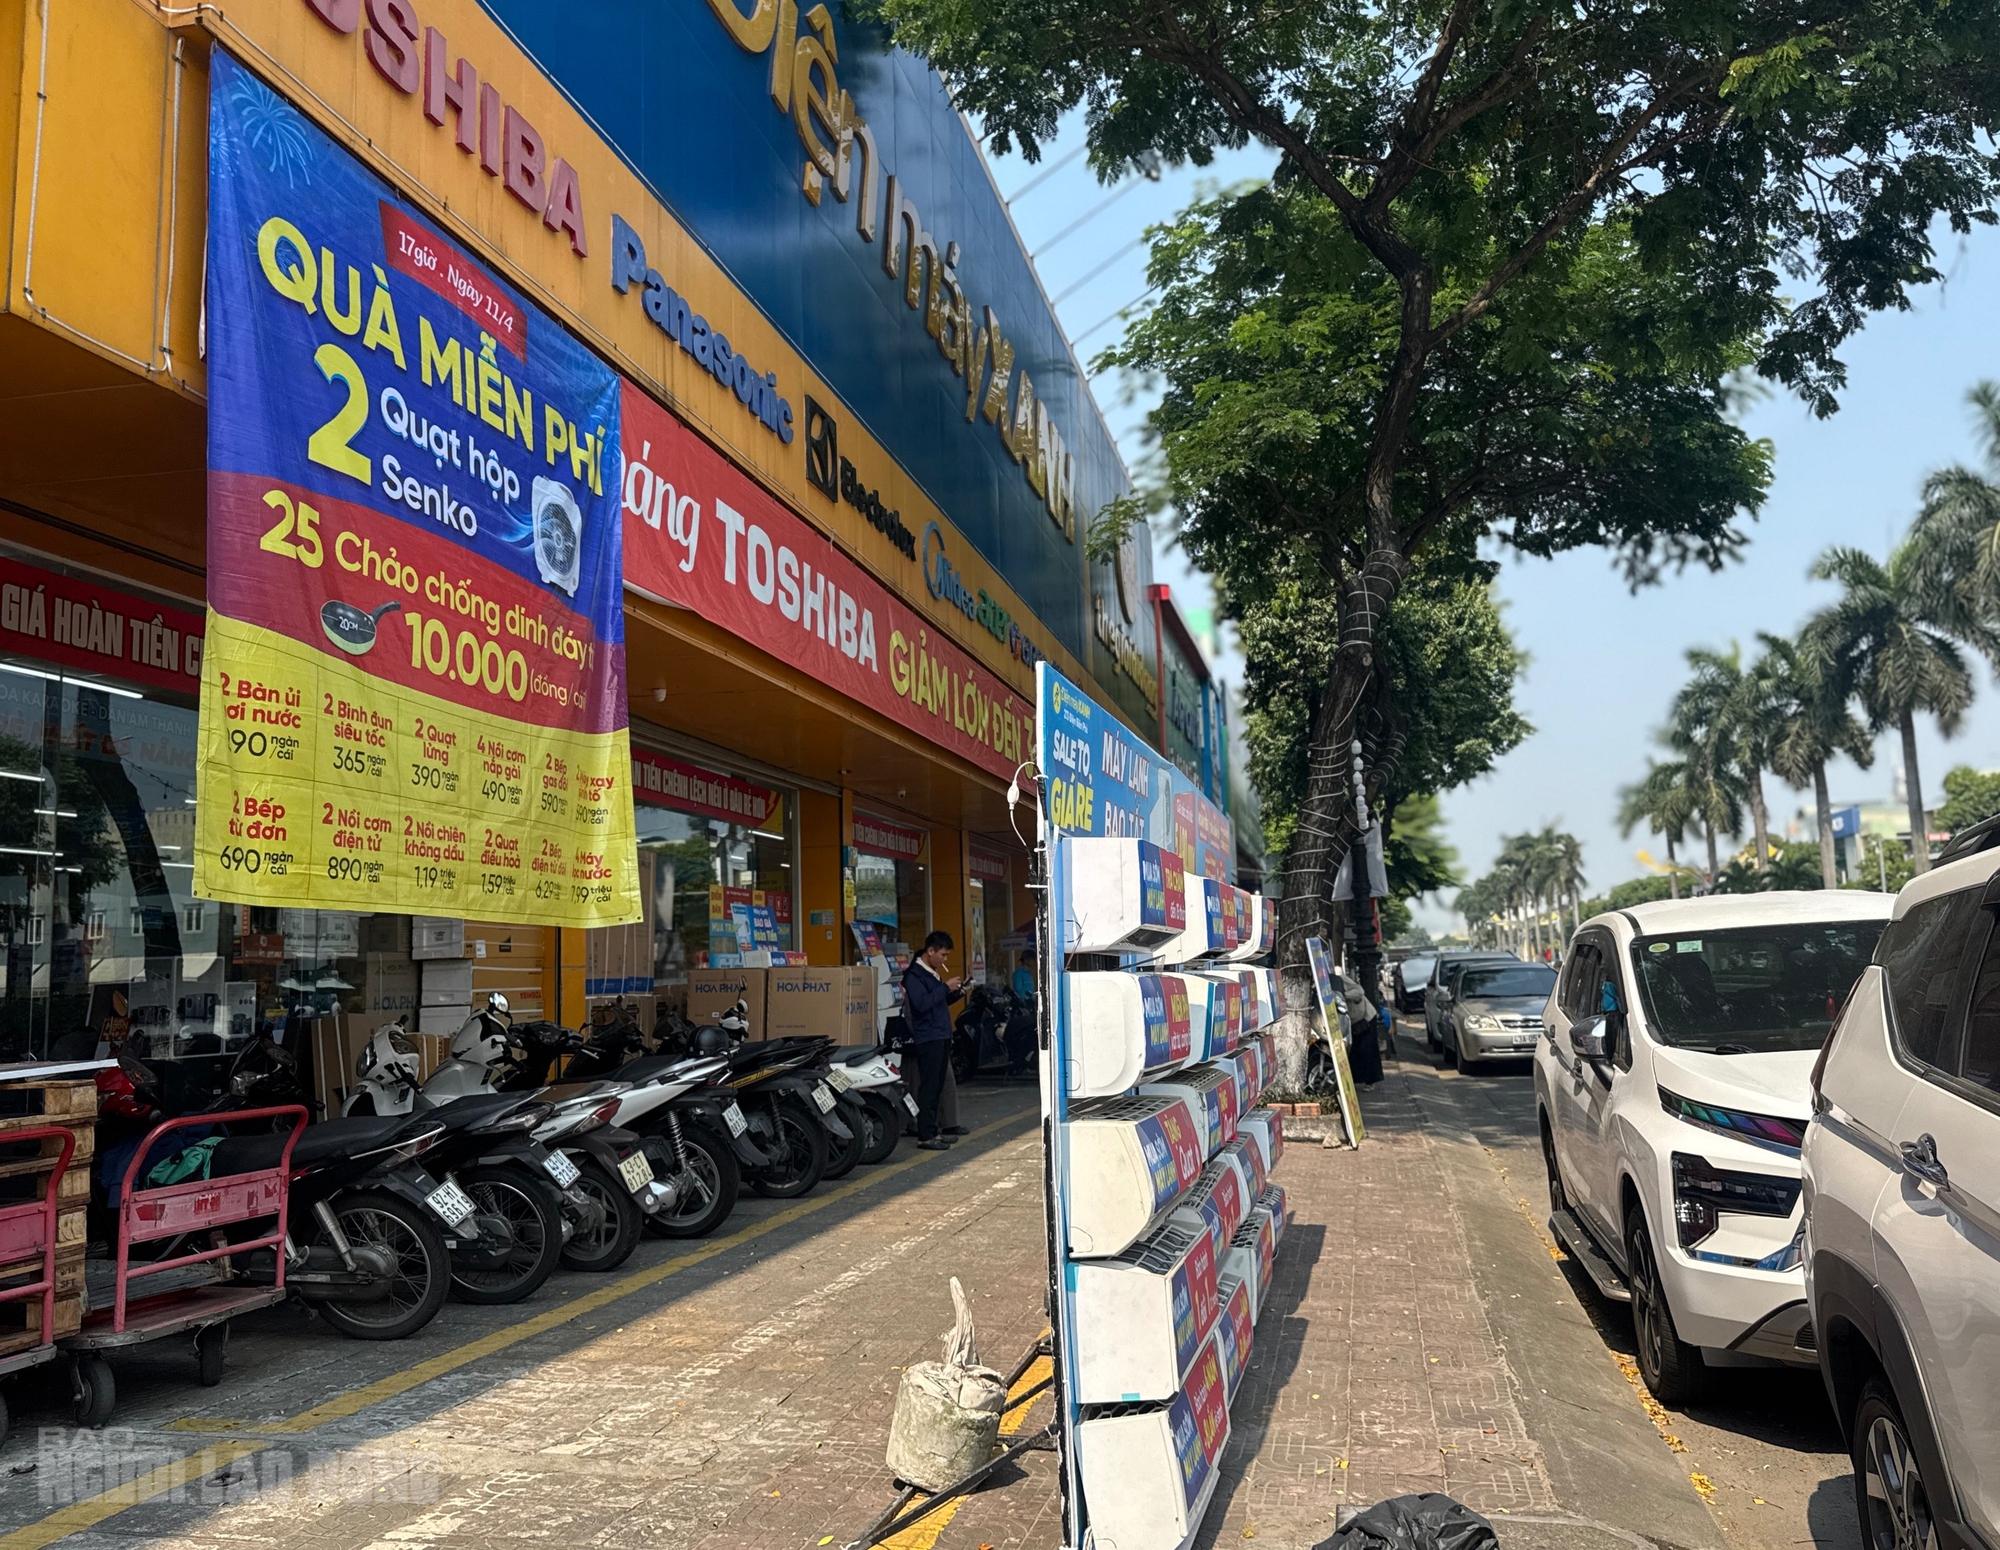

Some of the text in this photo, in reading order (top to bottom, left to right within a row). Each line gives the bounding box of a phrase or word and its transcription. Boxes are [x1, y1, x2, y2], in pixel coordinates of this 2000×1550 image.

[398, 230, 515, 333] 17giờ Ngày 11/4
[257, 216, 407, 372] QUÀ
[418, 315, 534, 453] MIỄN
[611, 213, 794, 444] Panasonic
[884, 174, 989, 424] máy
[982, 305, 1076, 545] XANH
[308, 343, 372, 486] 2
[380, 386, 520, 502] Quạt hộp
[381, 453, 478, 538] Senko
[259, 489, 587, 671] 25 Chảo chống đáy
[1, 583, 47, 639] GIÁ
[53, 596, 124, 658] HOÀN
[129, 613, 180, 672] TIỀN
[715, 496, 879, 674] TOSHIBA
[888, 629, 950, 722] GIẢM
[953, 668, 990, 747] LỚN
[992, 695, 1022, 766] ĐẾN
[404, 611, 528, 702] 10.000
[220, 671, 302, 708] 2 Bàn ủi
[21, 688, 90, 716] KARAOKE
[128, 708, 149, 729] ÂM
[151, 716, 192, 738] THANH
[224, 701, 302, 729] ơi nước
[323, 692, 394, 732] 2 Bình đun
[270, 734, 300, 748] ngàn
[333, 722, 387, 749] siêu tốc
[414, 717, 457, 751] 2 Quạt
[269, 745, 295, 761] /cái
[332, 746, 387, 774] 365 ngàn
[422, 741, 449, 766] lửng
[477, 734, 527, 765] 4 Nồi cơm
[1052, 729, 1091, 777] SALE TO
[411, 763, 460, 790] 390 ngàn
[482, 756, 521, 781] nắp gài
[545, 752, 568, 778] 2 Bếp
[1102, 729, 1128, 784] MÁY
[1128, 747, 1150, 799] LẠNH
[481, 779, 523, 804] 490 ngàn
[542, 774, 557, 790] gas
[588, 788, 602, 803] tố
[590, 776, 615, 790] xay
[643, 758, 662, 793] TIỀN
[662, 768, 689, 800] CHÊNH
[689, 774, 707, 808] LỆCH
[233, 790, 286, 823] 2 Bếp
[540, 791, 559, 814] 590
[1051, 772, 1076, 833] GIÁ
[228, 818, 287, 841] từ đơn
[322, 802, 393, 834] 2 Nồi cơm
[404, 815, 467, 844] 2 Nồi chiên
[333, 829, 383, 854] điện tử
[404, 838, 465, 863] không dầu
[484, 829, 519, 856] 2 Quạt
[541, 838, 563, 861] 2 Bếp
[219, 845, 294, 875] 690 ngàn
[327, 855, 385, 882] 890 ngàn
[480, 850, 521, 870] điều hoà
[531, 856, 549, 877] điện
[580, 851, 604, 868] Máy
[580, 867, 613, 880] nước
[413, 865, 457, 890] 1,19 triệu
[480, 873, 503, 896] 1,59
[590, 885, 613, 895] triệu
[431, 1184, 459, 1209] 92-H1
[442, 1195, 473, 1224] 696.19
